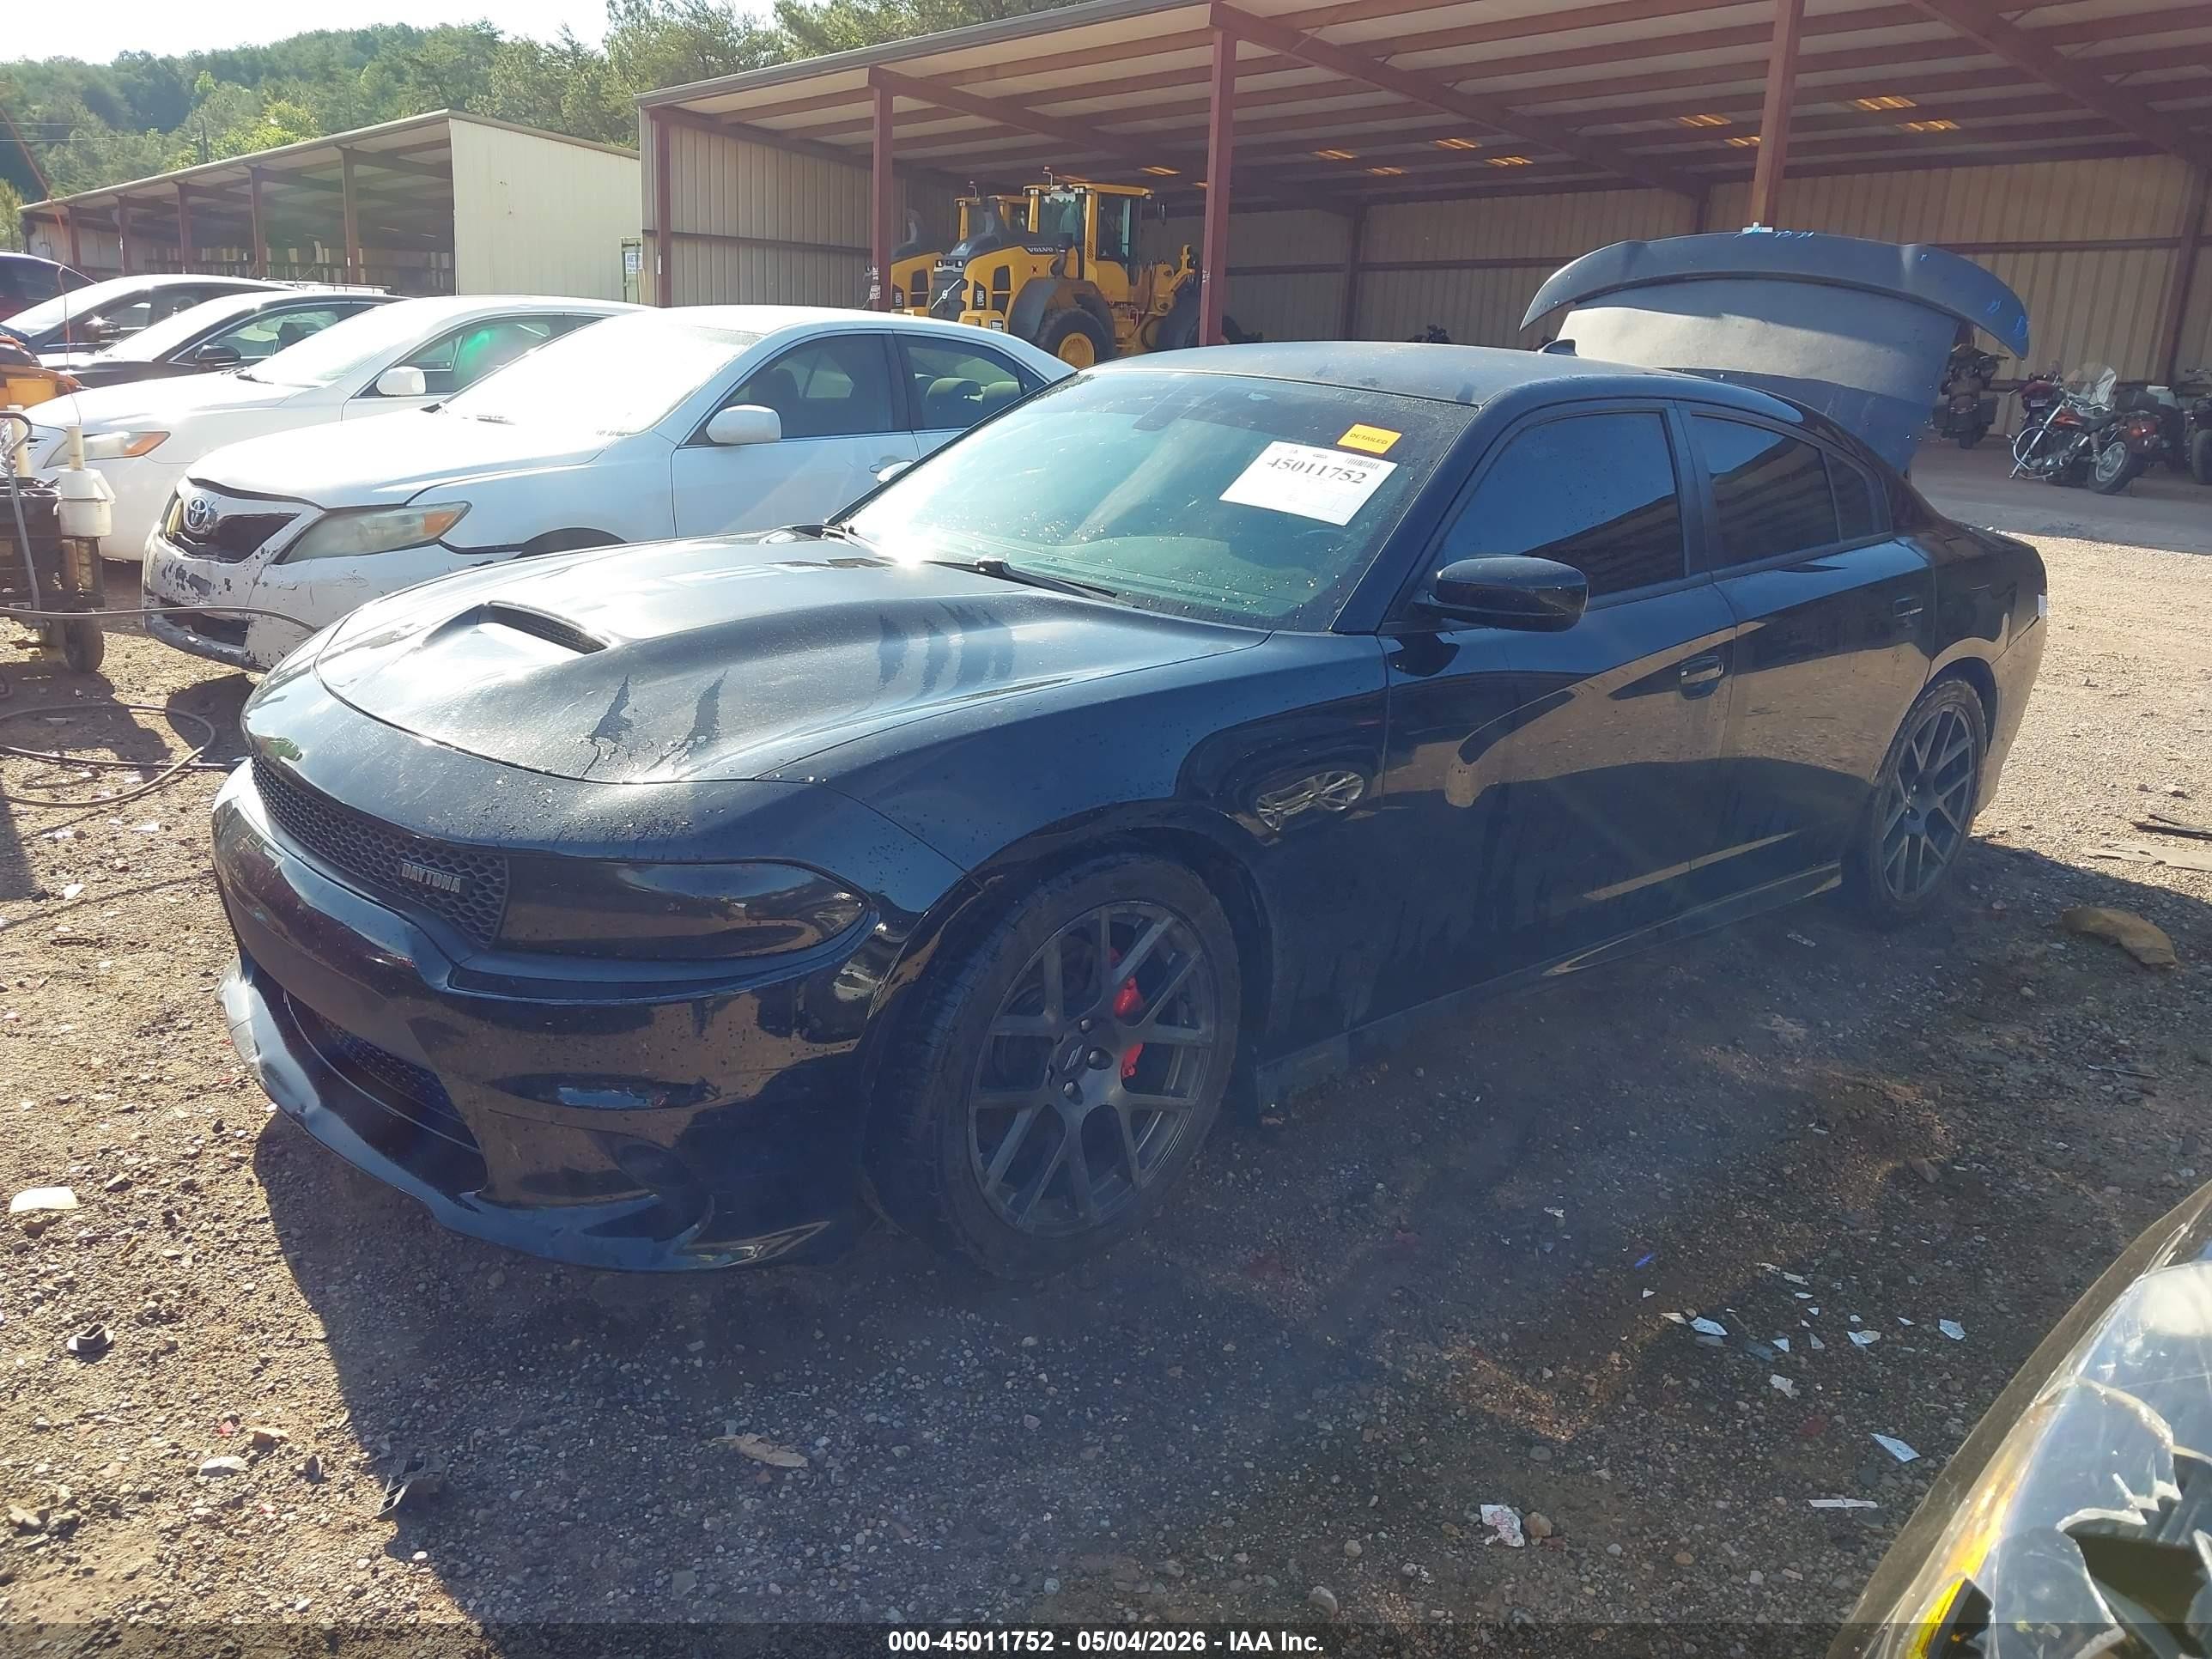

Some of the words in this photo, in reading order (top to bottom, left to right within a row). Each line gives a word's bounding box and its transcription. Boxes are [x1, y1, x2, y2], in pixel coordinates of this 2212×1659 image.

[976, 290, 985, 307] L90H
[1349, 433, 1389, 445] DETAILED
[1267, 457, 1368, 484] 45011752
[401, 862, 462, 894] DAYTONA
